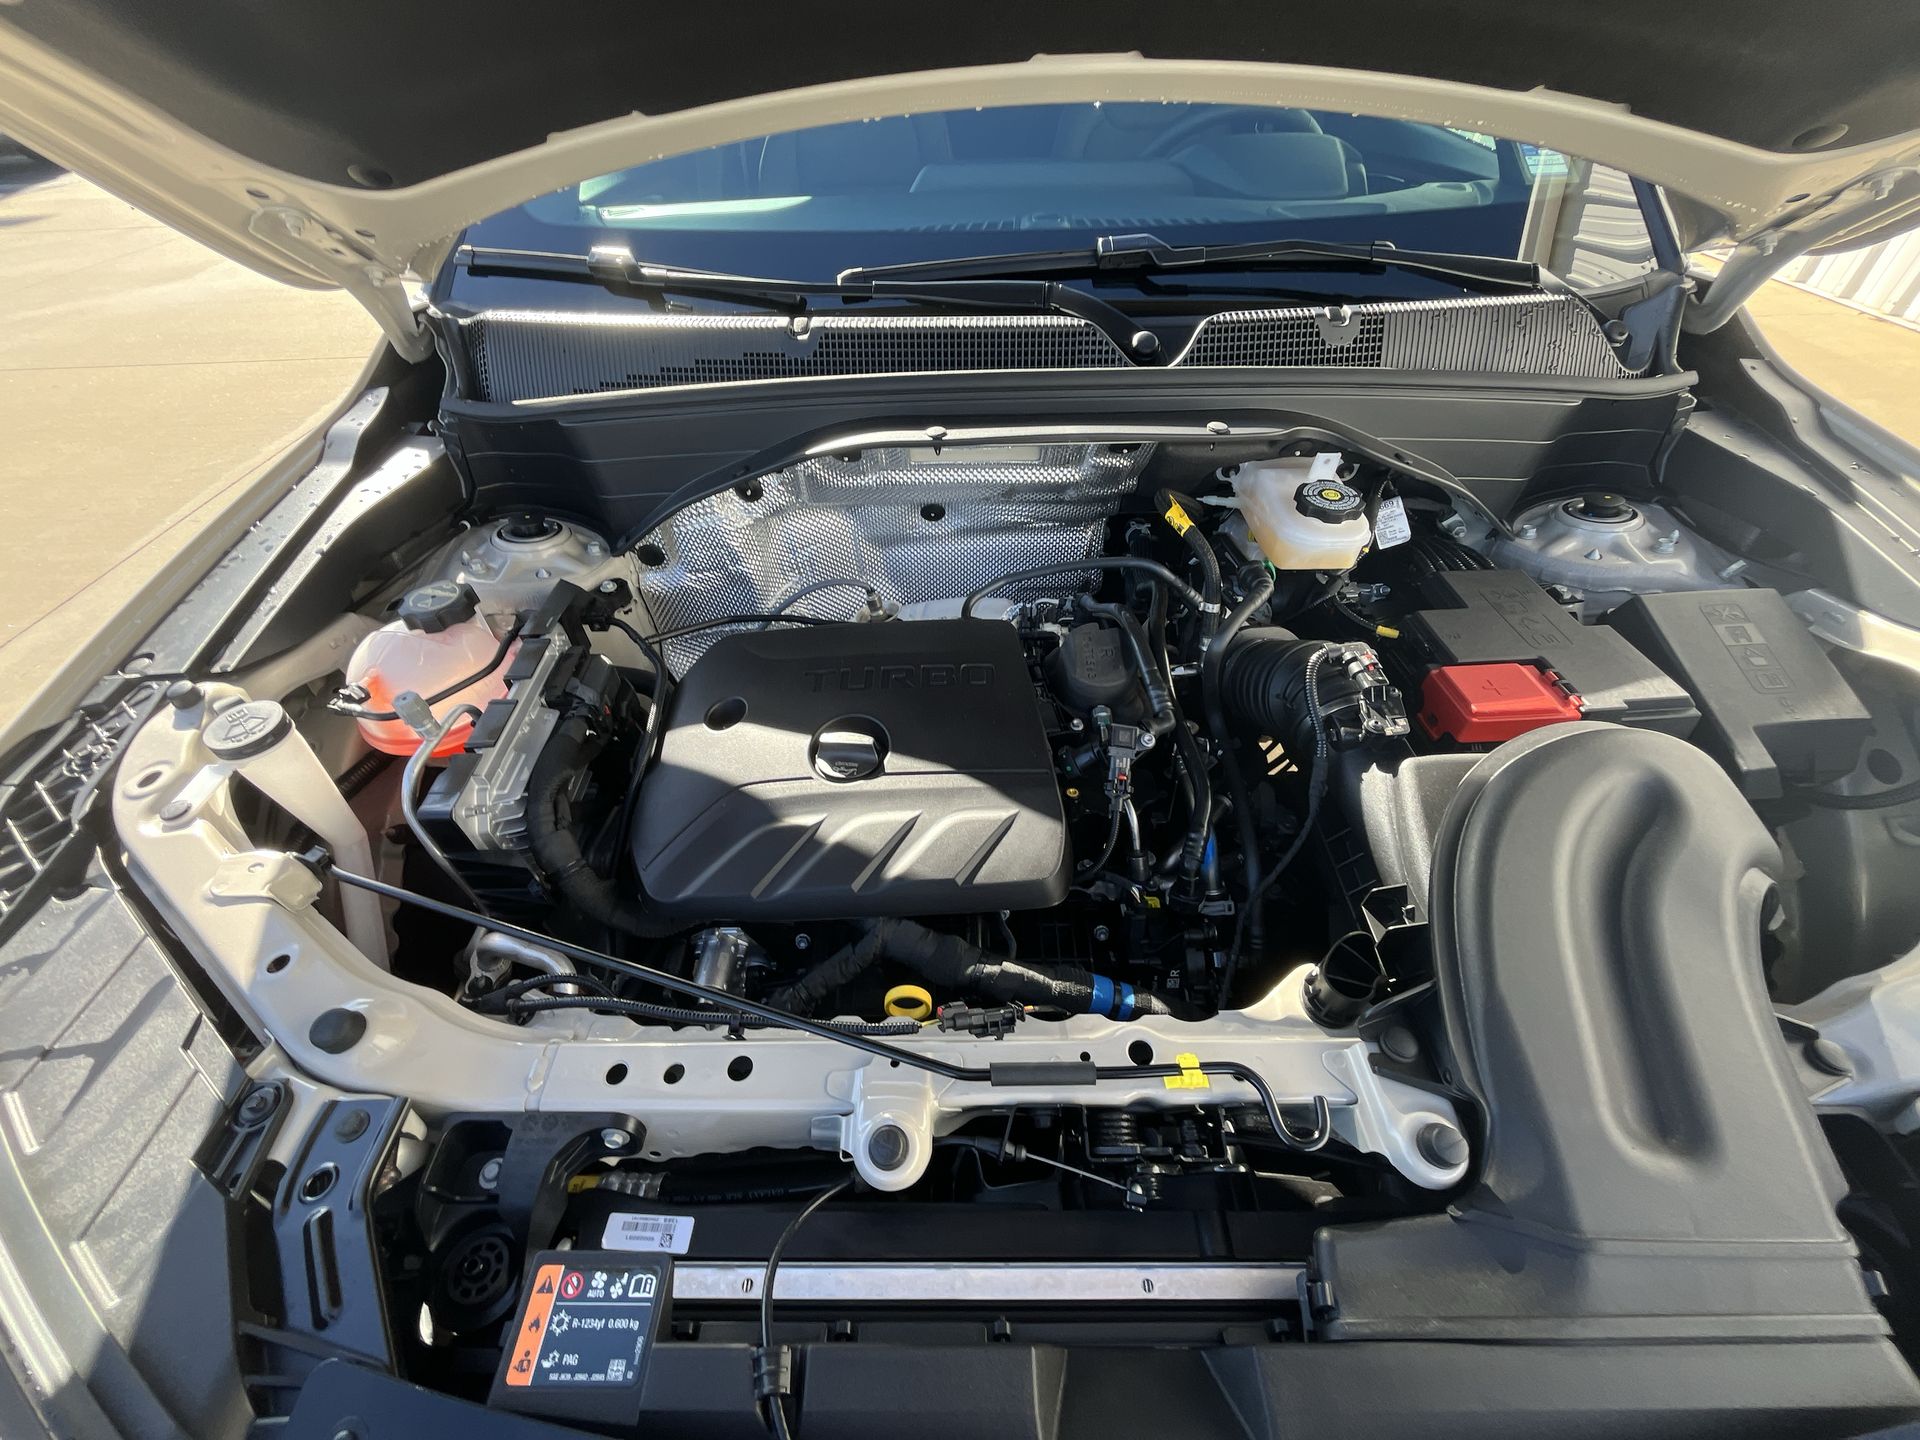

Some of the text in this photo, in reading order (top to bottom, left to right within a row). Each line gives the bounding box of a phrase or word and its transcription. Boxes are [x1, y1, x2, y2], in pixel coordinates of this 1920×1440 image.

[804, 663, 995, 693] TURBO
[587, 1289, 605, 1298] AUTO
[571, 1317, 606, 1331] R-1234yf
[629, 1317, 640, 1331] kg
[562, 1353, 579, 1366] PAG
